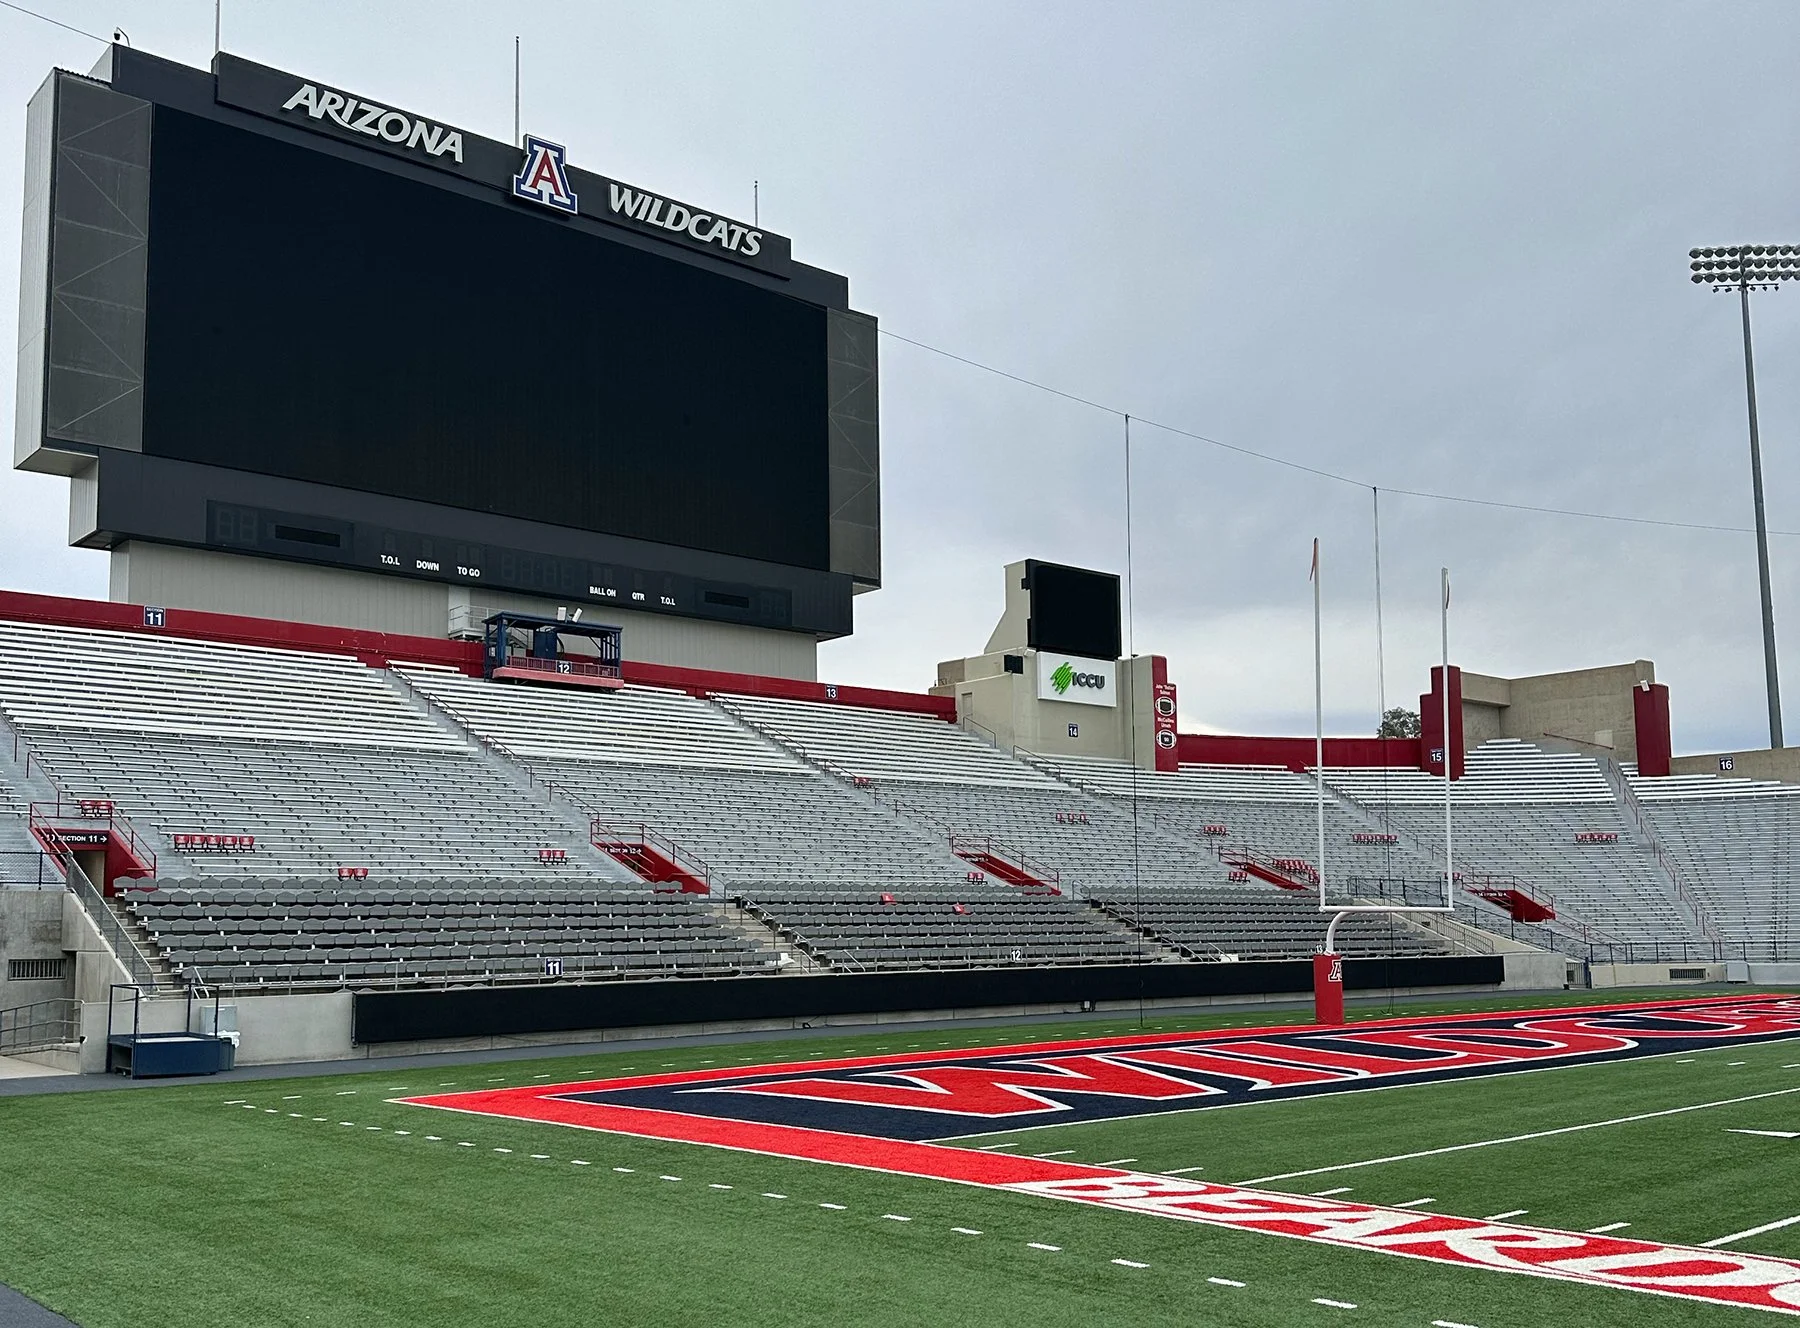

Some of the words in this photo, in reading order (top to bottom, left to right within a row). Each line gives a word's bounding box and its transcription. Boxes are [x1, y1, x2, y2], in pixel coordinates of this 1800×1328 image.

[282, 84, 464, 163] ARIZONA
[513, 134, 578, 216] A
[609, 184, 763, 257] WILDCATS
[380, 555, 400, 565] T.O.L
[416, 560, 439, 571] DOWN
[457, 566, 467, 576] TO
[469, 568, 480, 577] GO
[589, 586, 606, 596] BALL
[606, 589, 616, 597] ON
[632, 592, 645, 600] QTR
[660, 597, 675, 605] T.O.L
[147, 612, 162, 626] 11
[559, 663, 570, 674] 12
[1071, 671, 1106, 690] ICCU
[826, 688, 836, 698] 13
[1069, 727, 1078, 737] 14
[1431, 752, 1442, 762] 15
[1721, 760, 1733, 770] 16
[1315, 944, 1323, 953] 13
[1011, 950, 1020, 960] 12
[547, 962, 560, 975] 11
